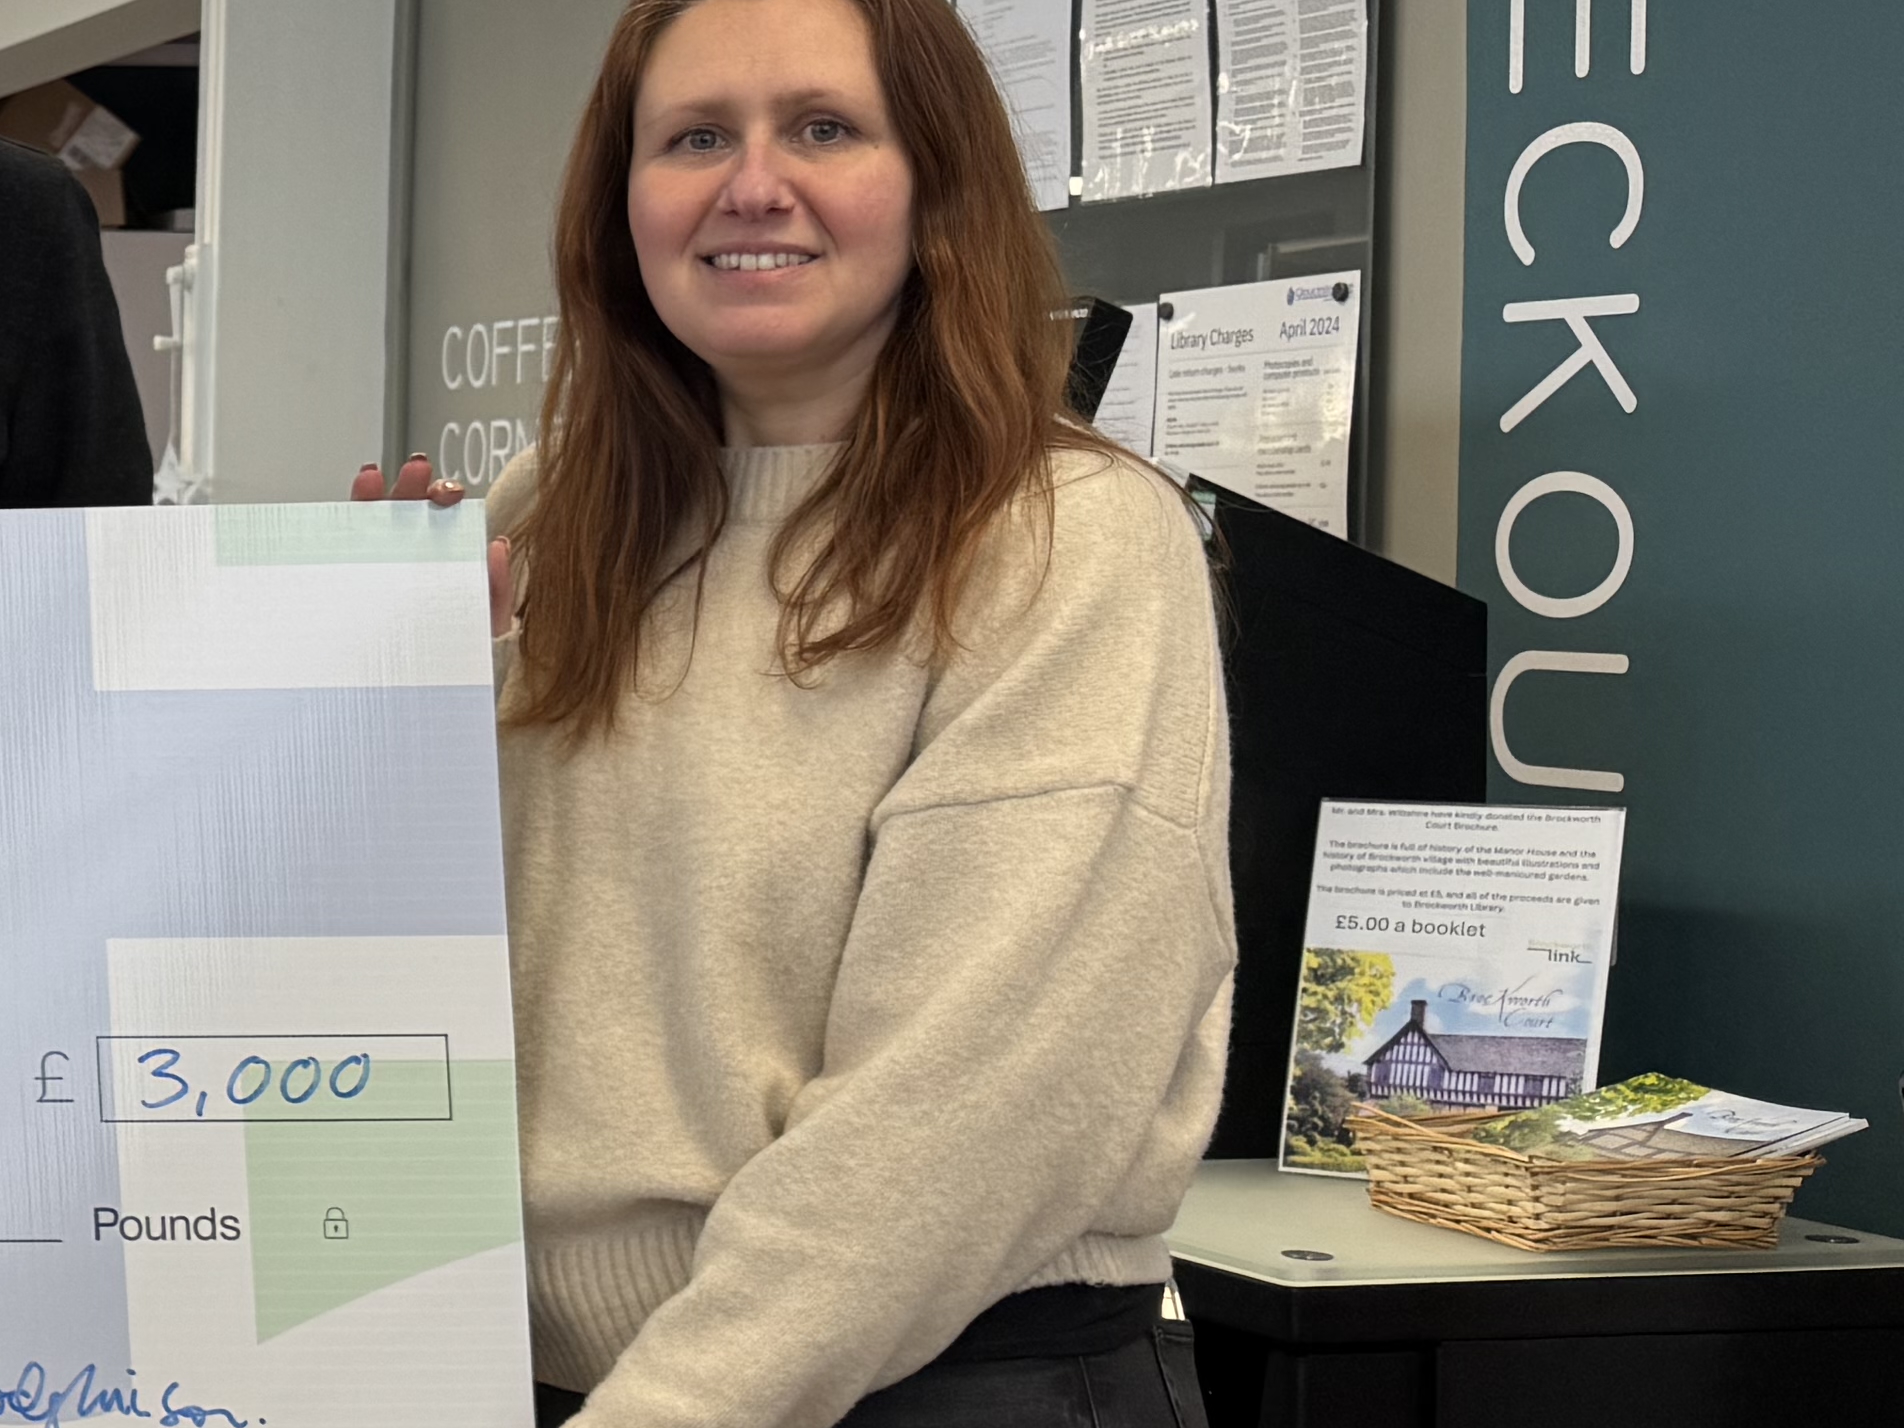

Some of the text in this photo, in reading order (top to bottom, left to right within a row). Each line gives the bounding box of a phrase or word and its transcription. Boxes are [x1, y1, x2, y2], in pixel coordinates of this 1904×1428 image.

[1170, 325, 1254, 351] Library Charges
[1279, 315, 1341, 341] April 2024
[1334, 915, 1486, 938] £5.00 a booklet
[1544, 948, 1584, 964] link
[34, 1049, 75, 1105] £
[137, 1047, 372, 1118] 3,000
[92, 1204, 242, 1245] Pounds
